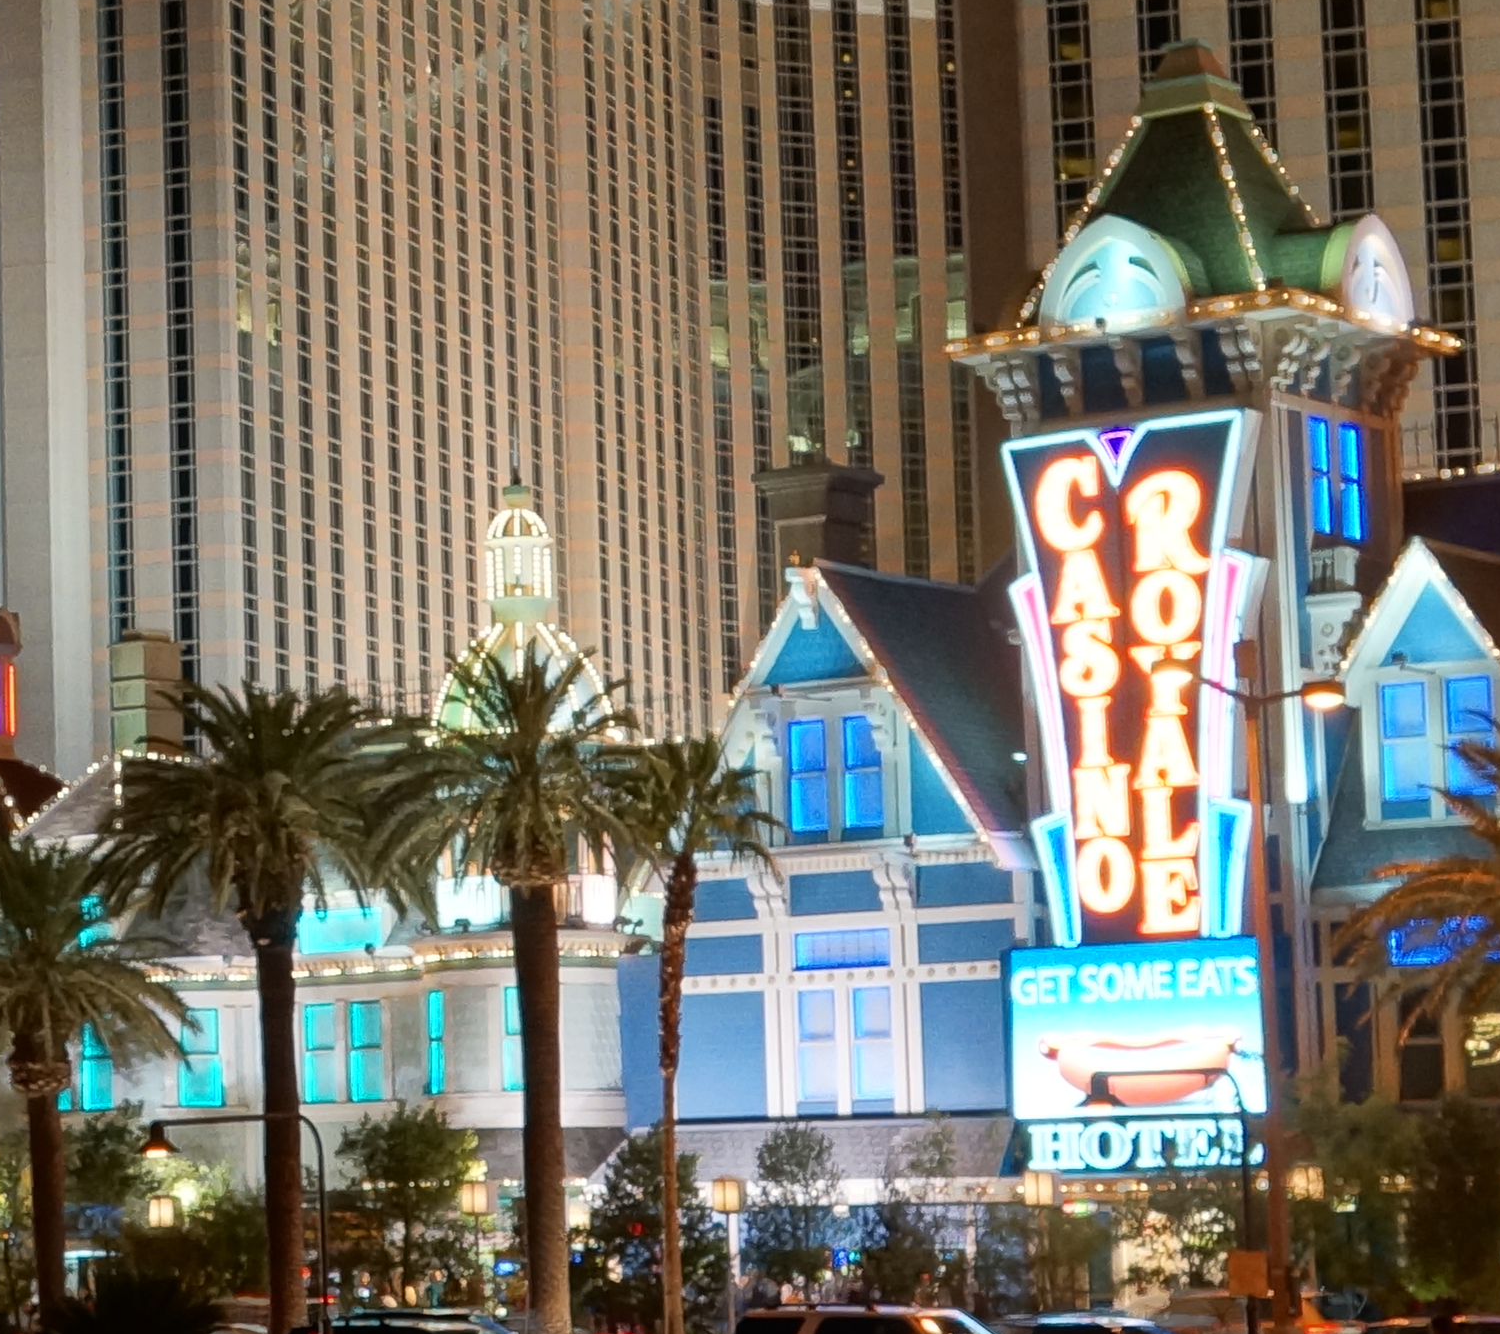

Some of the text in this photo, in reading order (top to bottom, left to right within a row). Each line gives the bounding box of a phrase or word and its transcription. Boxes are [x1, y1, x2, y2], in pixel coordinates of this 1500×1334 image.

[1035, 455, 1213, 935] CASINO ROYALE
[1010, 956, 1258, 1006] GET SOME EATS
[1027, 1118, 1266, 1170] HOTEL
